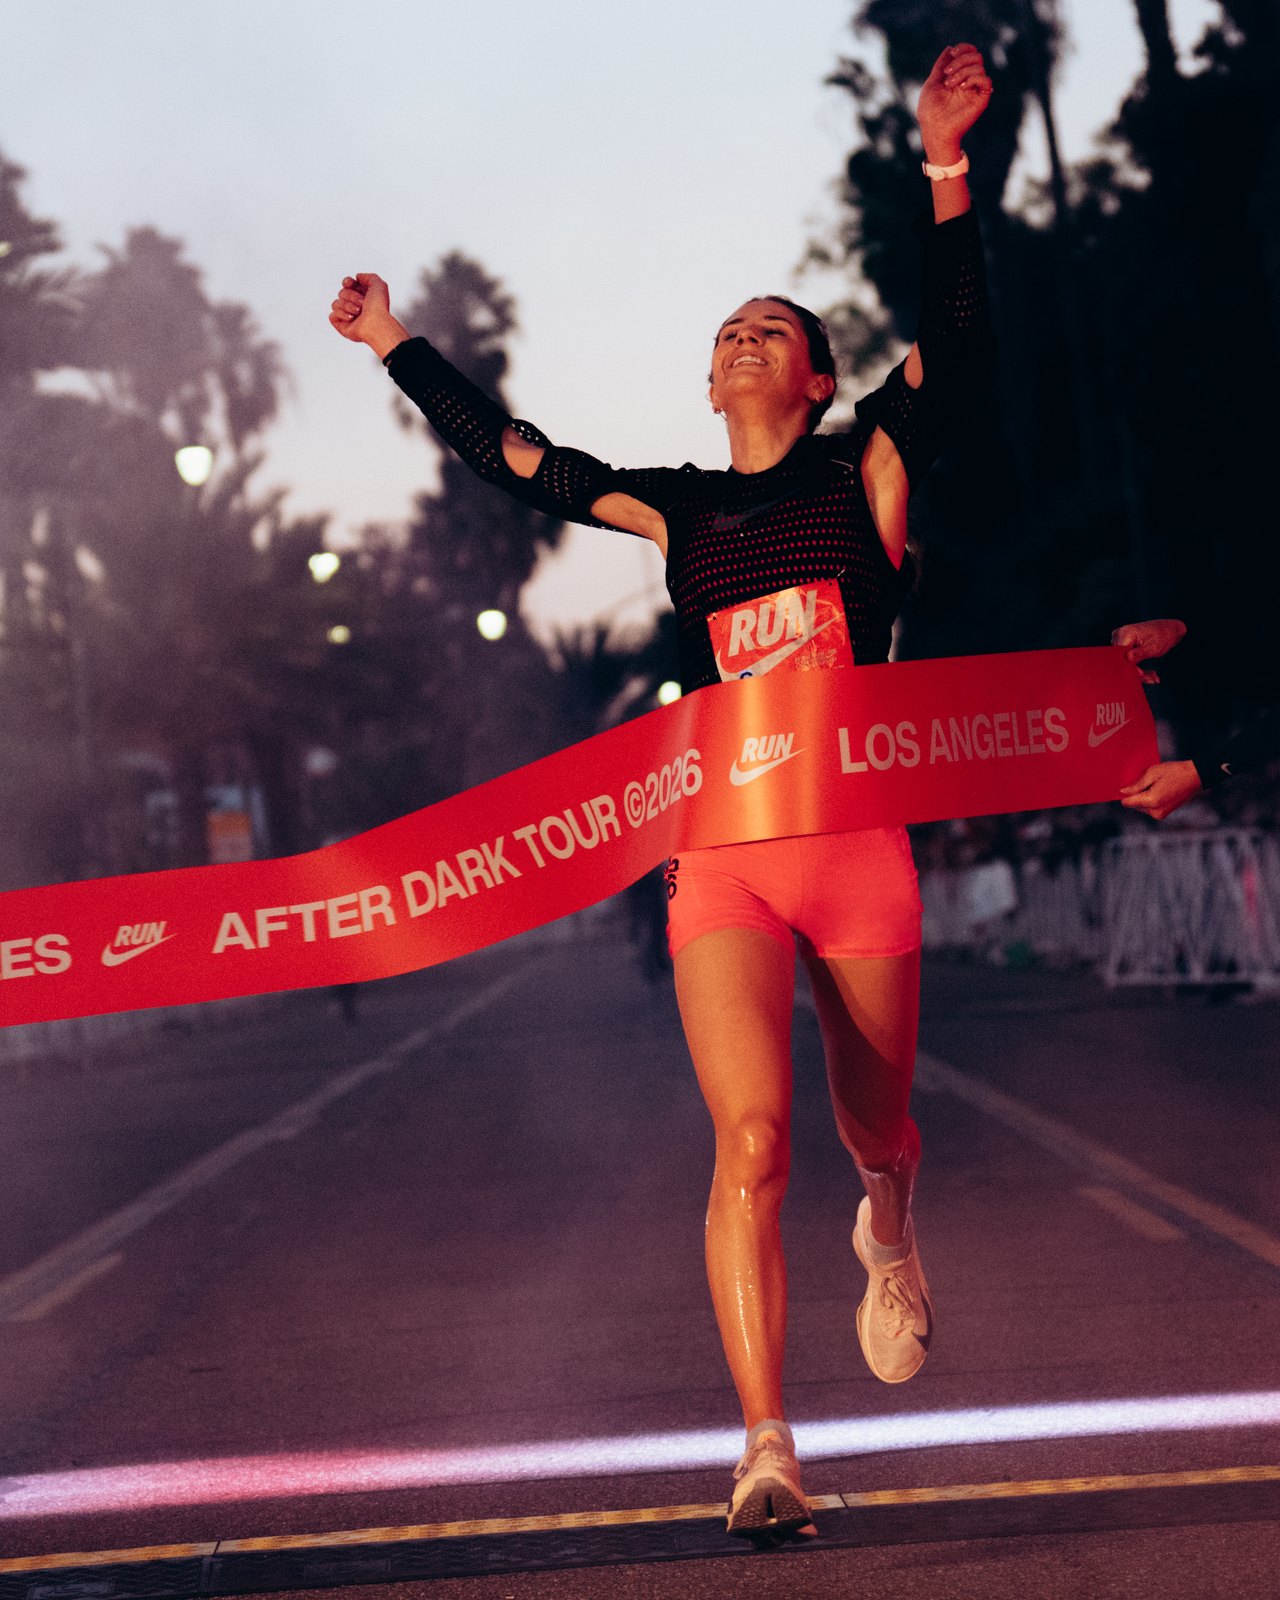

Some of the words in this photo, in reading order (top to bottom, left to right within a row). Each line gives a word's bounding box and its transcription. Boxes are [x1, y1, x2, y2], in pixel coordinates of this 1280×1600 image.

[728, 589, 817, 657] RUN
[1097, 703, 1125, 726] RUN
[741, 733, 794, 763] RUN
[838, 721, 921, 774] LOS
[929, 707, 1069, 764] ANGELES
[212, 885, 396, 954] AFTER
[401, 836, 523, 917] DARK
[513, 795, 622, 868] TOUR
[623, 748, 703, 828] ©2026
[114, 921, 167, 947] RUN
